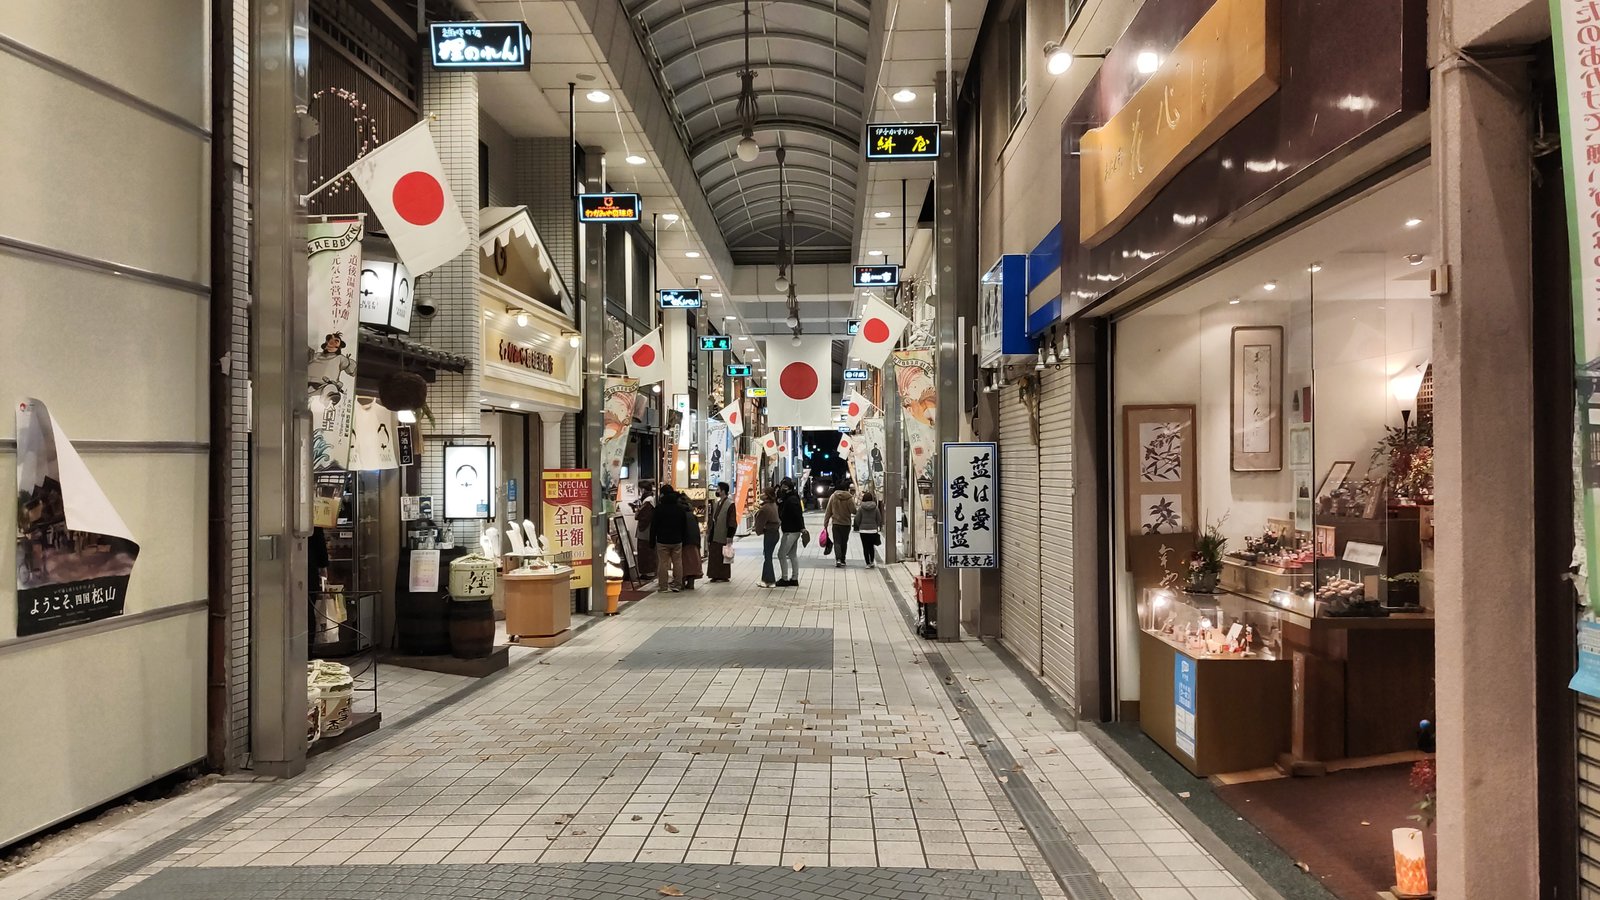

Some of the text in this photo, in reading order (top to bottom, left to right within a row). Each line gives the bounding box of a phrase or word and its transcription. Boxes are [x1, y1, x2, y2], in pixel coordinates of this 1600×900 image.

[558, 481, 589, 489] SPECIAL
[558, 489, 579, 498] SALE
[969, 452, 991, 531] 藍は愛
[554, 507, 584, 525] 全品
[950, 475, 970, 549] 愛も藍
[554, 529, 584, 547] 半額
